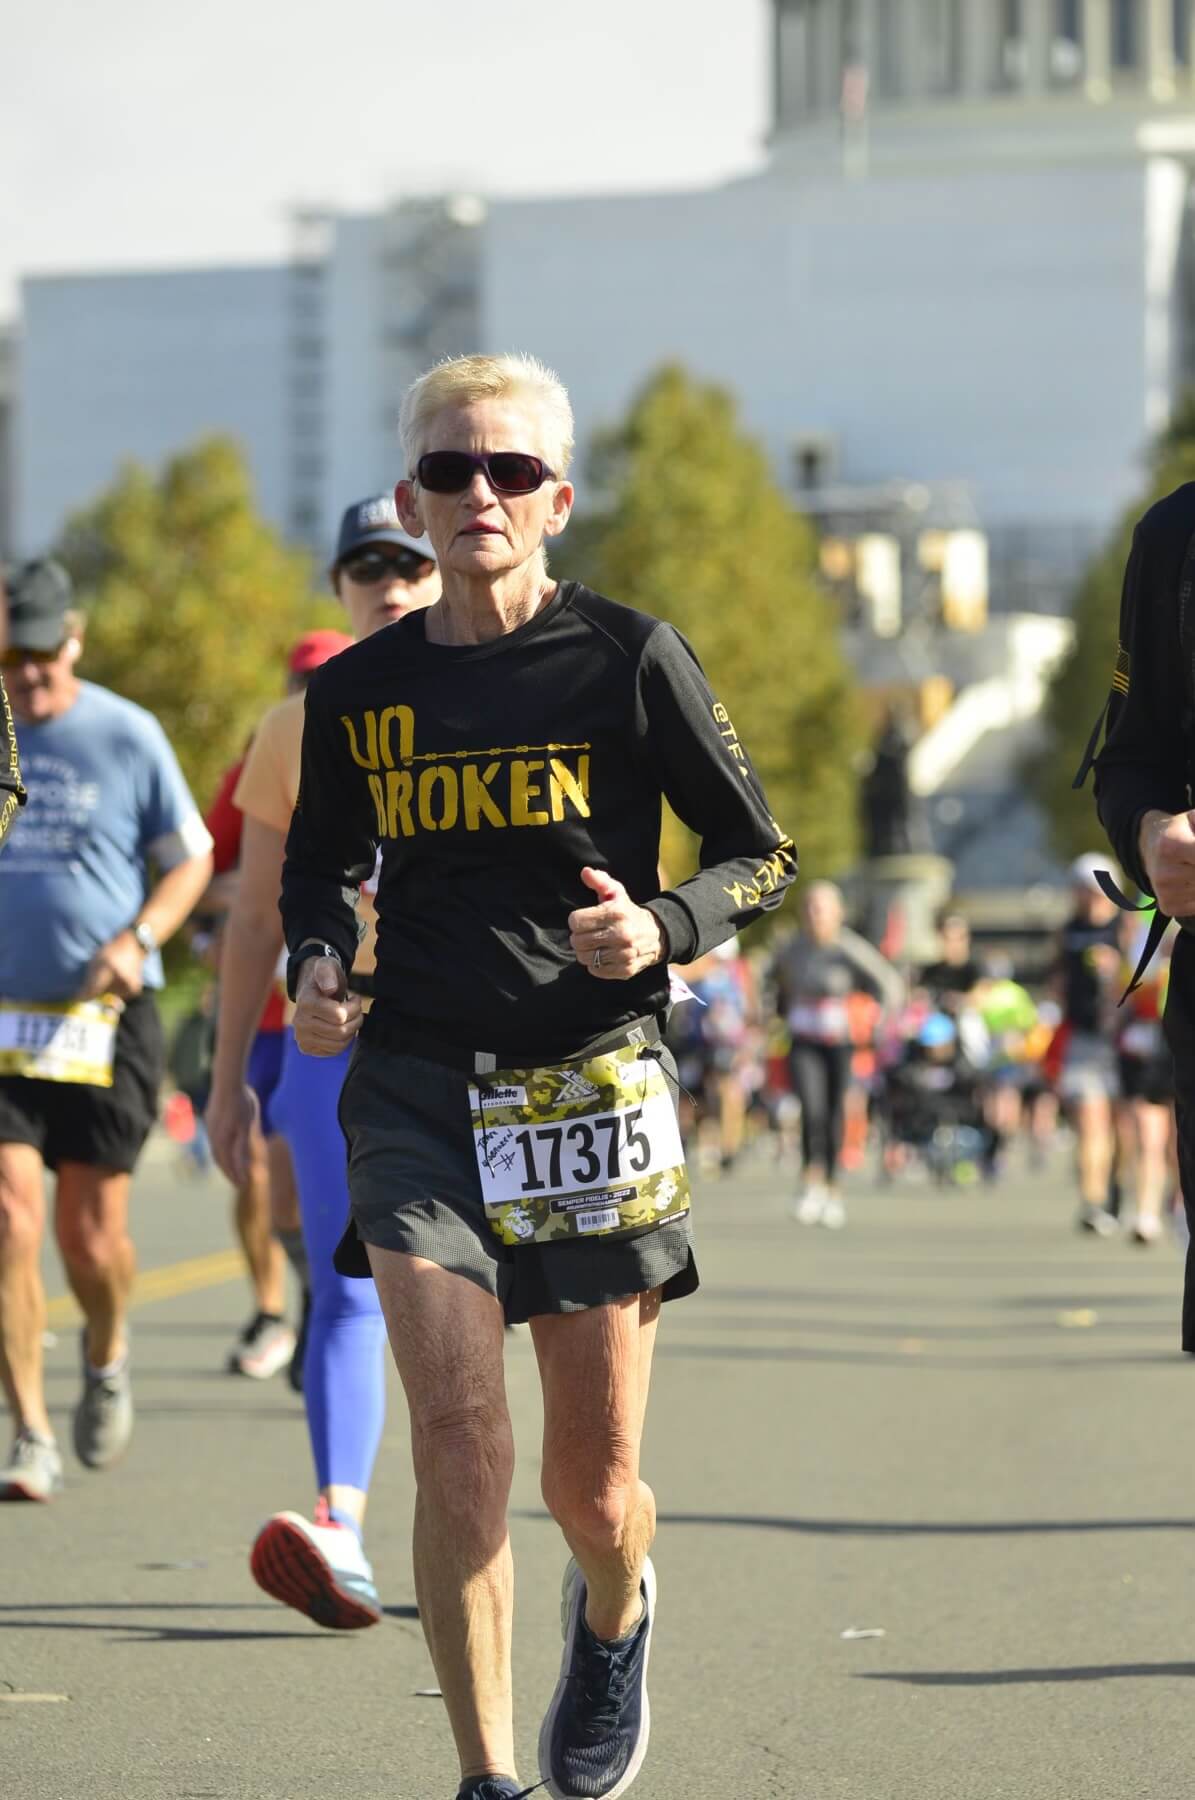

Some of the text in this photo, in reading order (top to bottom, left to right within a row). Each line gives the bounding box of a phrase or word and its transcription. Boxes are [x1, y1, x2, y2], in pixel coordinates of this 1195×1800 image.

[339, 704, 415, 770] UN
[367, 754, 591, 839] BROKEN
[515, 1108, 651, 1192] 17375
